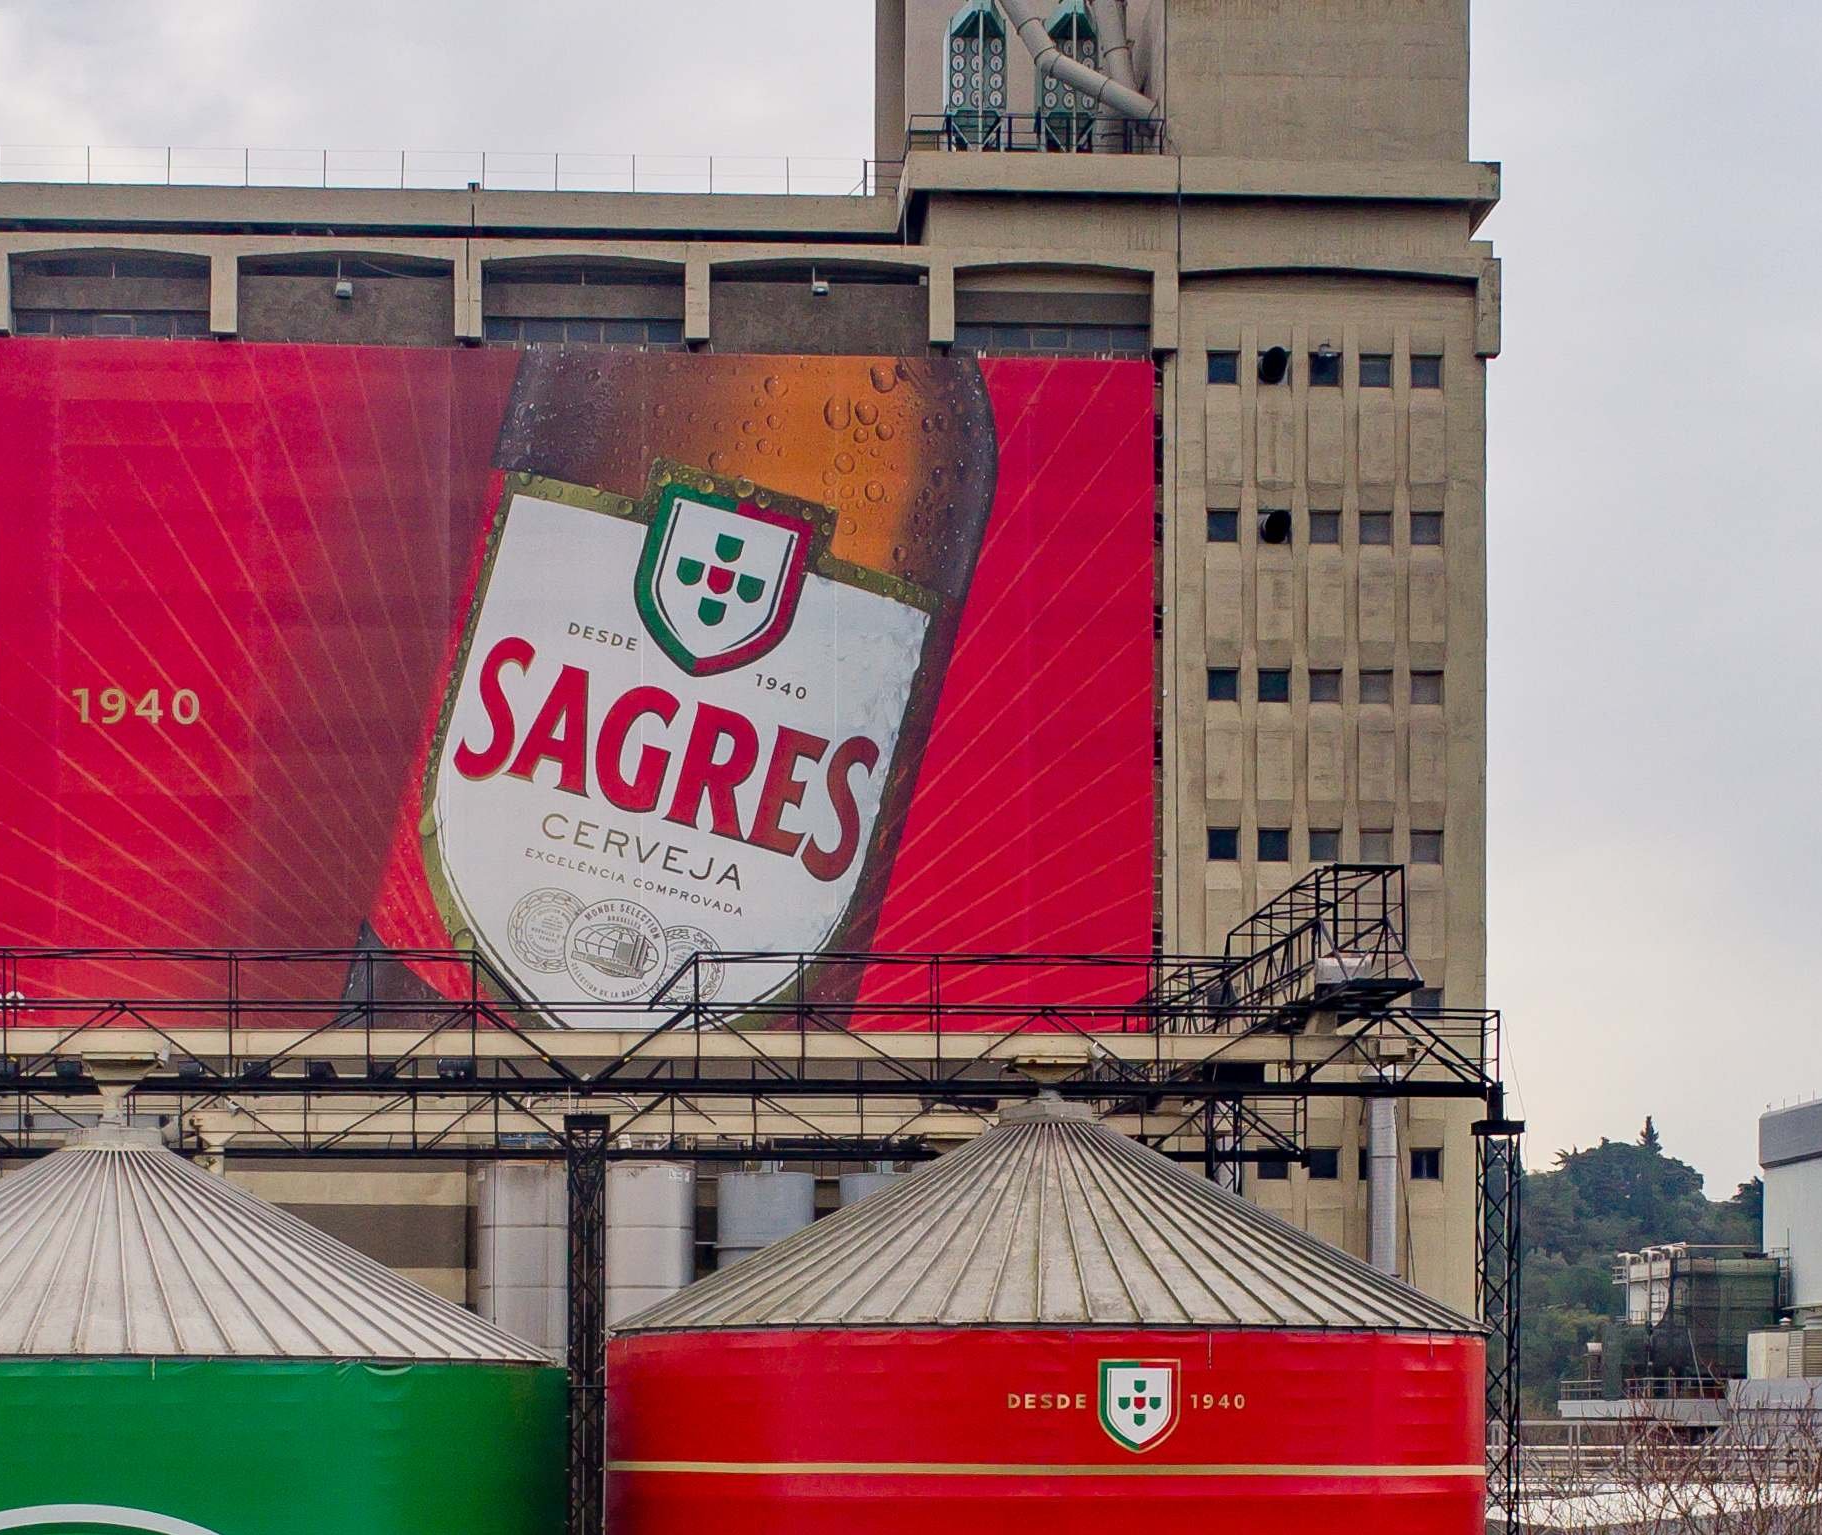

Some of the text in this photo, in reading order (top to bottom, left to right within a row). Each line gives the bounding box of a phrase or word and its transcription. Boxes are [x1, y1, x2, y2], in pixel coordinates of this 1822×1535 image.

[567, 620, 809, 702] DESDE 1940
[72, 687, 202, 727] 1940
[453, 635, 881, 884] SAGRES
[524, 846, 744, 917] EXCELÊNCIA COMPROVADA
[541, 812, 743, 891] CERVEJA
[1007, 1392, 1247, 1410] DESDE 1940
